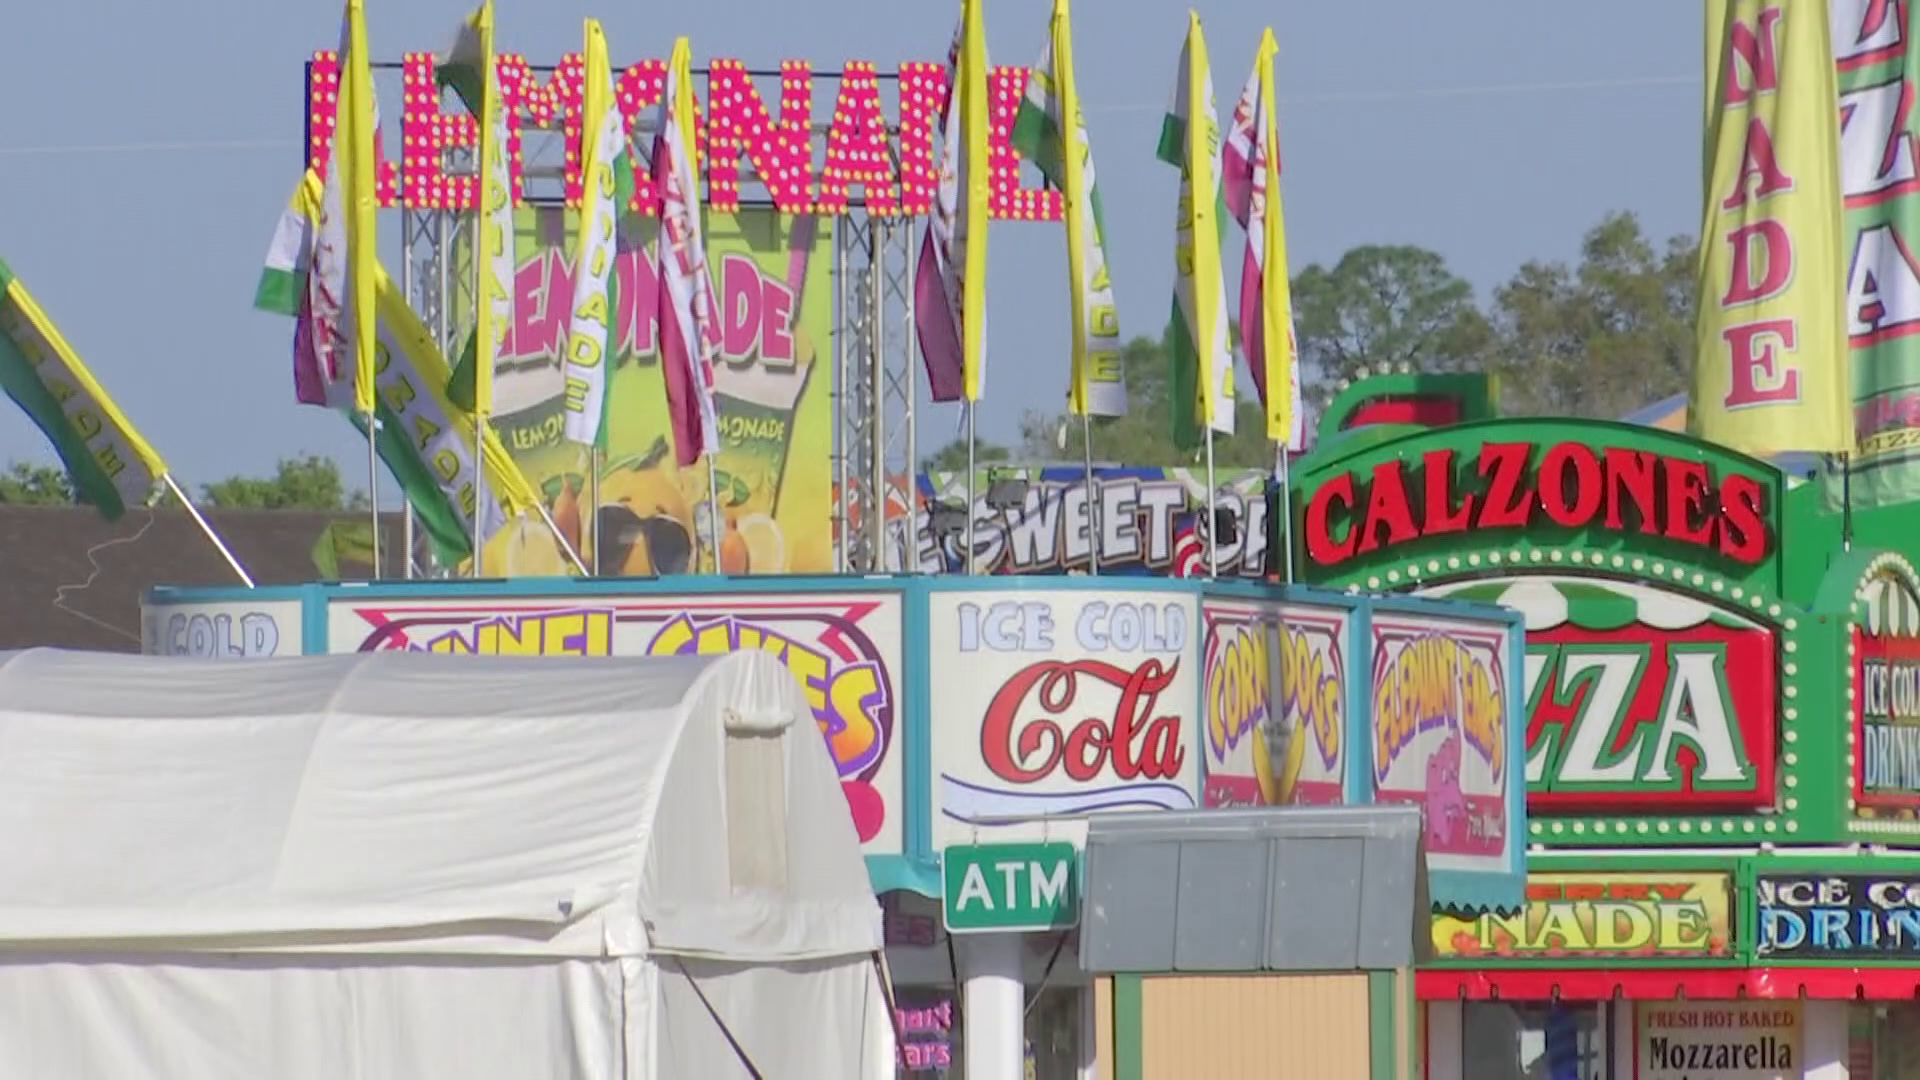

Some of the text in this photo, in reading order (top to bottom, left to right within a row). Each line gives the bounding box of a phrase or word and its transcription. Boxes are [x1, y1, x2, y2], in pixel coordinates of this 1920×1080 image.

[1722, 7, 1798, 408] NADE
[497, 246, 794, 362] EMDE
[968, 478, 1189, 570] SWEET
[1306, 442, 1767, 565] CALZONES
[168, 612, 279, 656] COLD
[958, 600, 1188, 653] ICE COLD
[1208, 621, 1340, 773] CORN DOGS
[1864, 663, 1888, 716] ICE
[980, 654, 1186, 784] Cola
[956, 860, 1069, 911] ATM
[1757, 878, 1851, 907] ICE
[1479, 901, 1711, 952] NADE
[1648, 1009, 1795, 1028] FRESH HOT BAKED
[1650, 1035, 1792, 1071] Mozzarella
